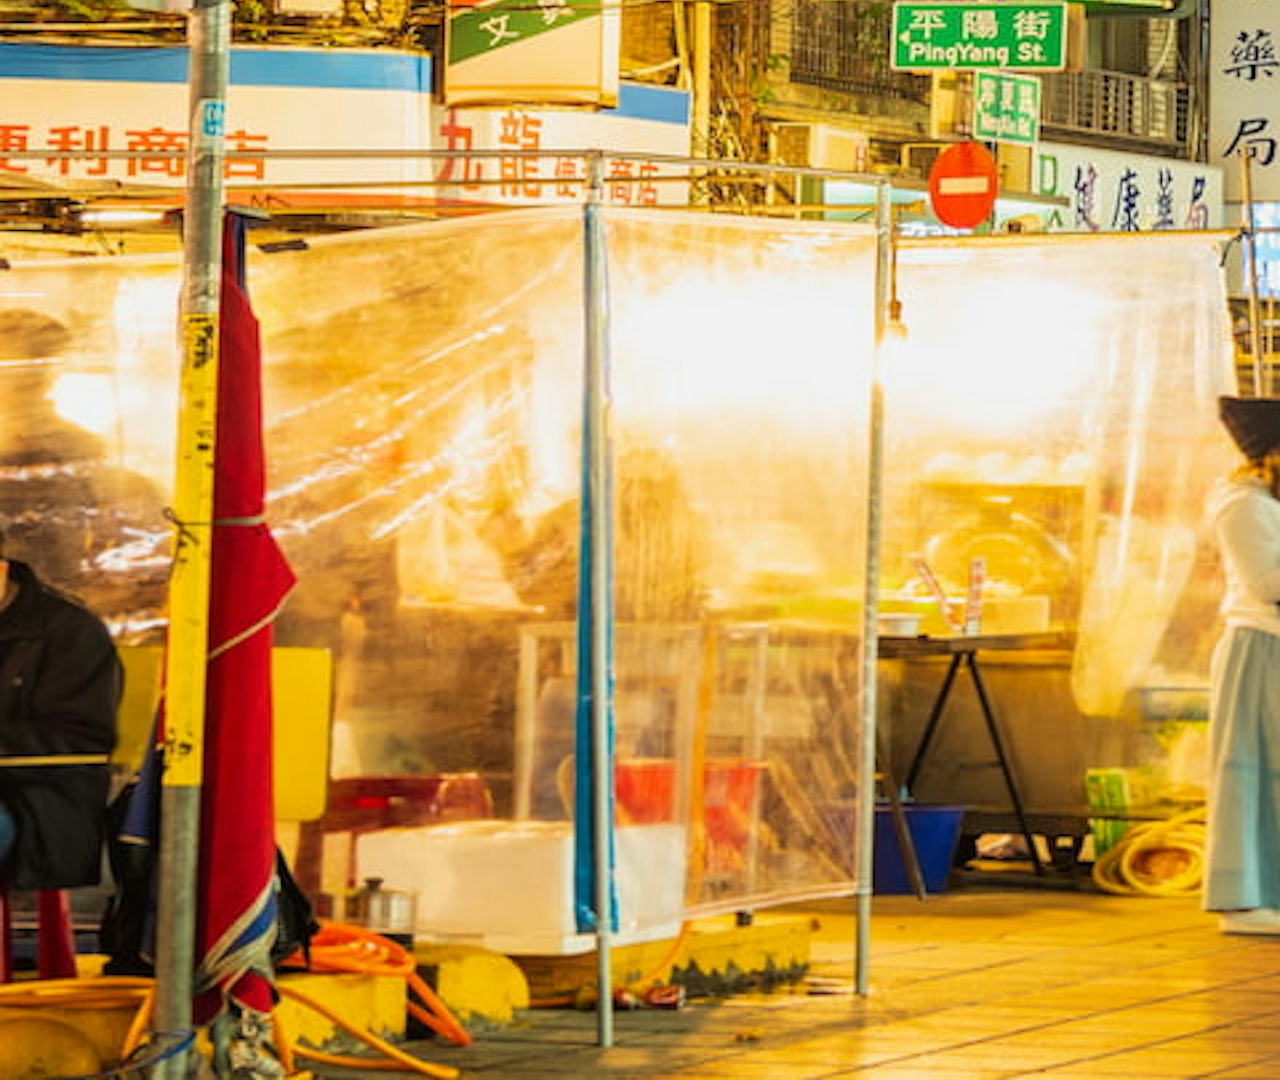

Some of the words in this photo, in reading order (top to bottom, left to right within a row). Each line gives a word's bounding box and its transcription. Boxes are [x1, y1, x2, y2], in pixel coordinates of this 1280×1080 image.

[909, 9, 1052, 41] 平陽街
[909, 42, 1010, 65] PingYang
